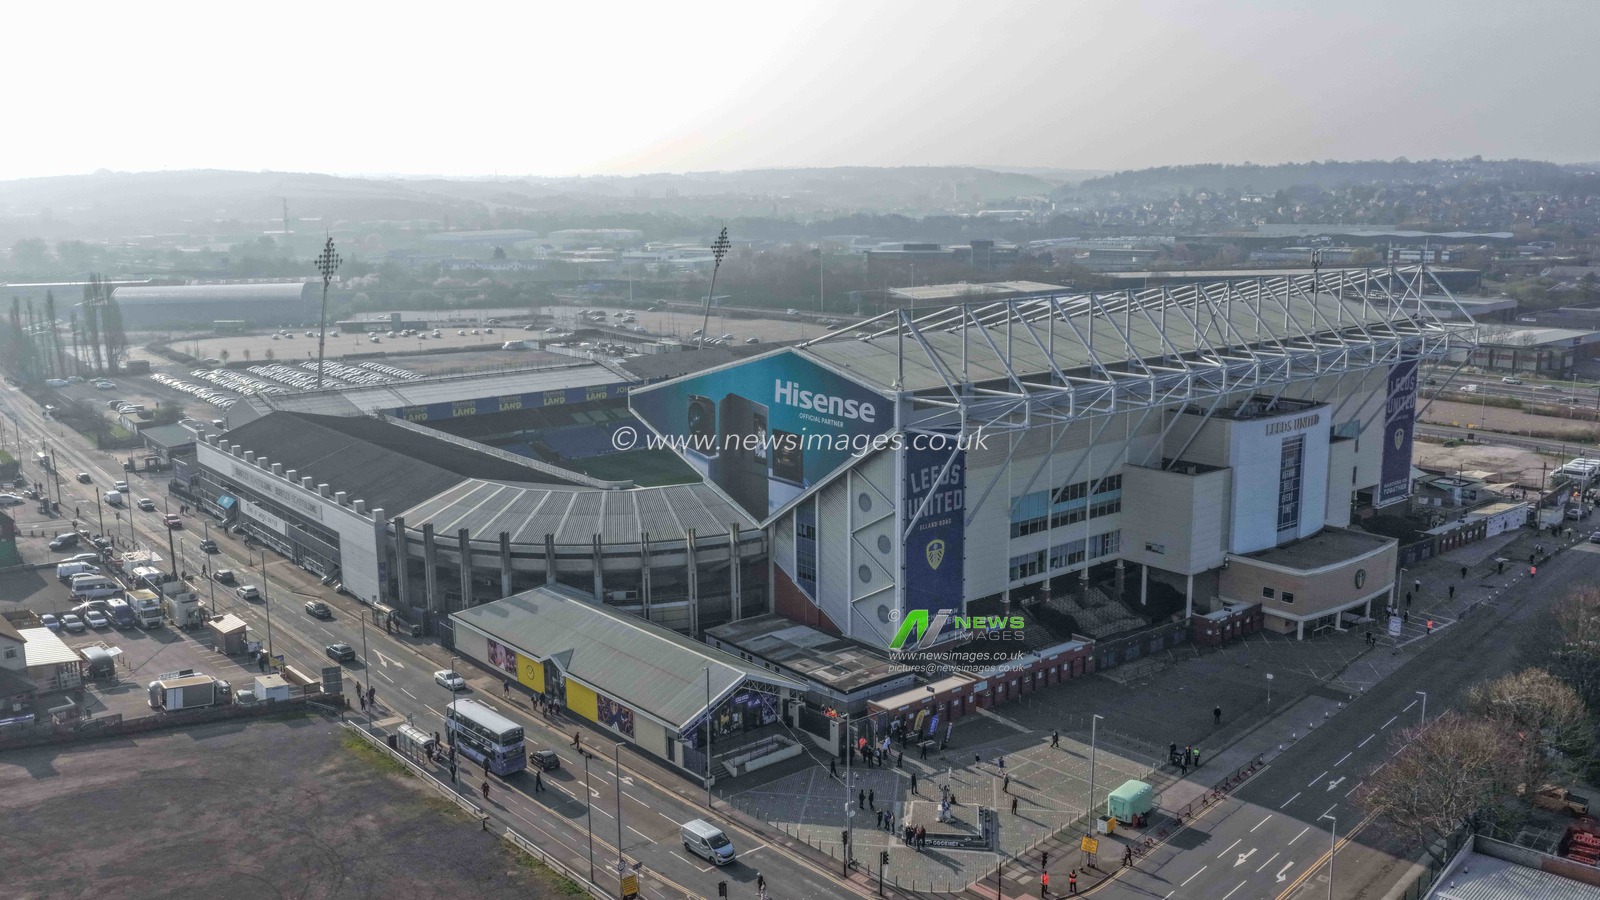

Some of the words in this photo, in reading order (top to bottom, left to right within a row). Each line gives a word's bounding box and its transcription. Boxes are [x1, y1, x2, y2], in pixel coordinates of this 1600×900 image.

[543, 397, 566, 406] LAND
[586, 392, 607, 400] LAND
[775, 379, 876, 423] Hisense
[453, 407, 477, 417] LAND
[499, 402, 522, 411] LAND
[403, 413, 428, 421] LAND
[799, 412, 821, 424] OFFICIAL
[821, 418, 844, 429] PARTNER
[1265, 421, 1293, 436] LEEDS
[911, 464, 961, 493] LEEDS
[908, 489, 963, 520] UNITED
